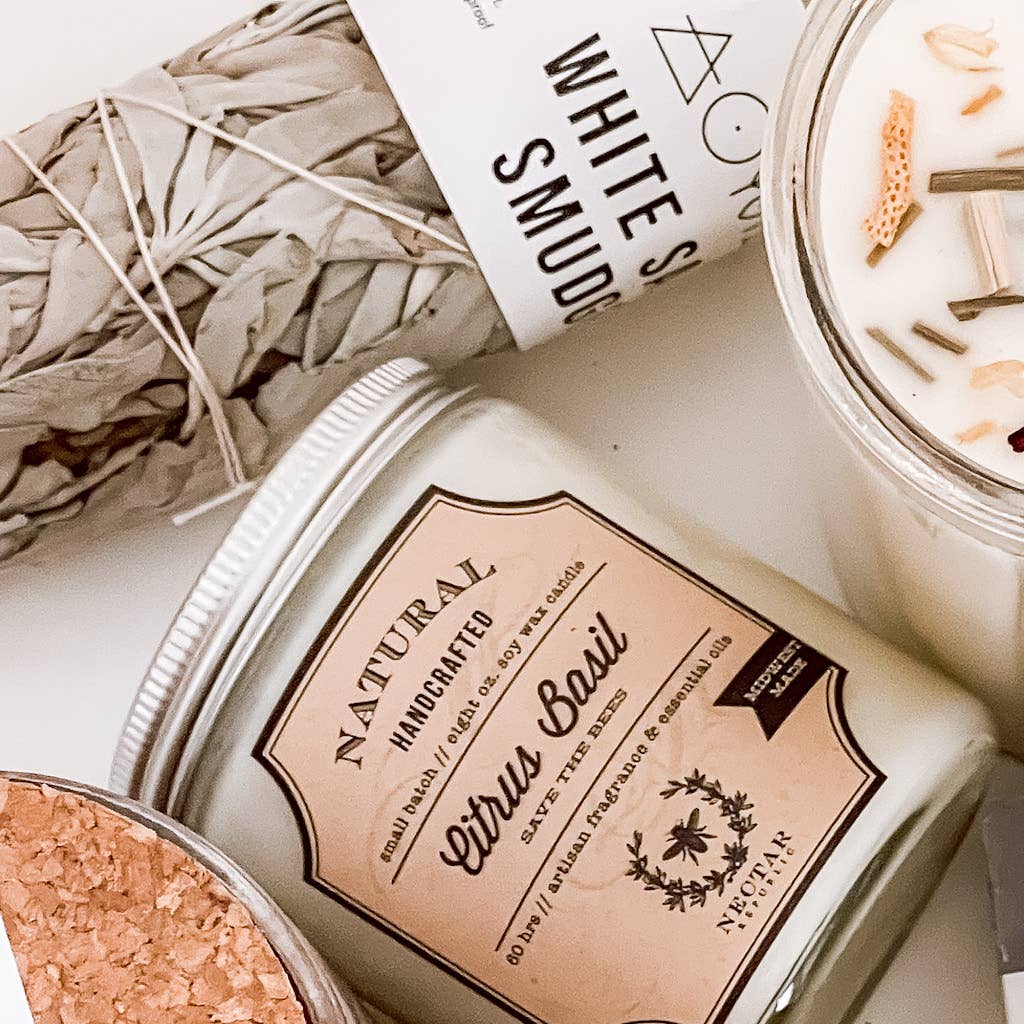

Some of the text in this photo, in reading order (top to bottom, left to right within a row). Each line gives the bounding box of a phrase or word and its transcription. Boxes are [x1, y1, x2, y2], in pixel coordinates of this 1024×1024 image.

[542, 32, 702, 286] WHITE S
[335, 557, 497, 770] NATURAL
[379, 817, 409, 863] small
[404, 767, 438, 815] batch
[447, 700, 481, 744] eight
[478, 673, 500, 697] oz.
[498, 639, 522, 670] soy
[519, 606, 548, 637] wax
[546, 560, 586, 604] candle
[388, 609, 494, 752] HANDCRAFTED
[439, 610, 628, 876] Citrus Basil
[520, 688, 628, 845] SAVE THE BEES
[517, 914, 541, 945] hrs
[547, 832, 591, 894] artisan
[586, 743, 648, 829] fragrance
[643, 725, 660, 742] &
[658, 658, 712, 725] essential
